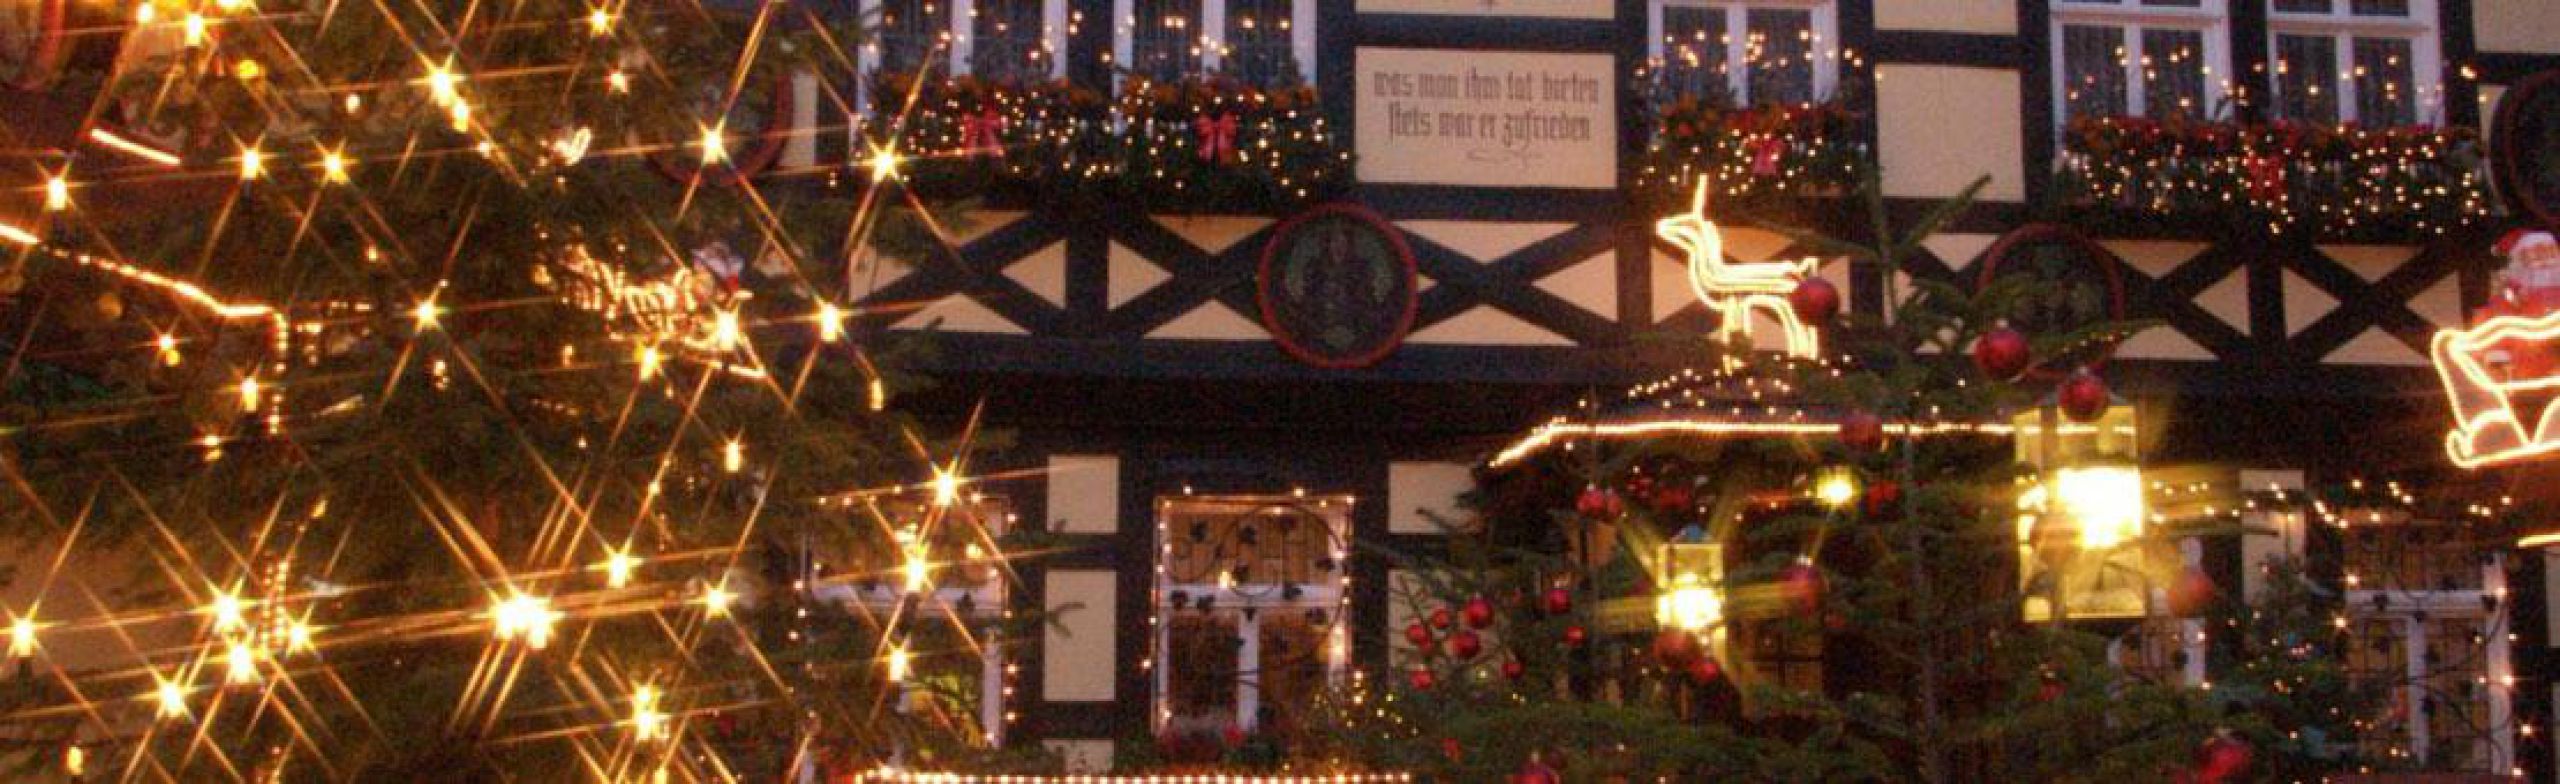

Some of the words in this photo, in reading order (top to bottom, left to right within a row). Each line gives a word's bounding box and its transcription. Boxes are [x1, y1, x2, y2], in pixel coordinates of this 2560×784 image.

[1374, 71, 1412, 98] was
[1418, 73, 1458, 99] man
[1464, 65, 1500, 102] ihm
[1507, 71, 1534, 101] tat
[1438, 111, 1474, 138] war
[1479, 111, 1497, 139] er
[1502, 108, 1590, 147] zufrieden
